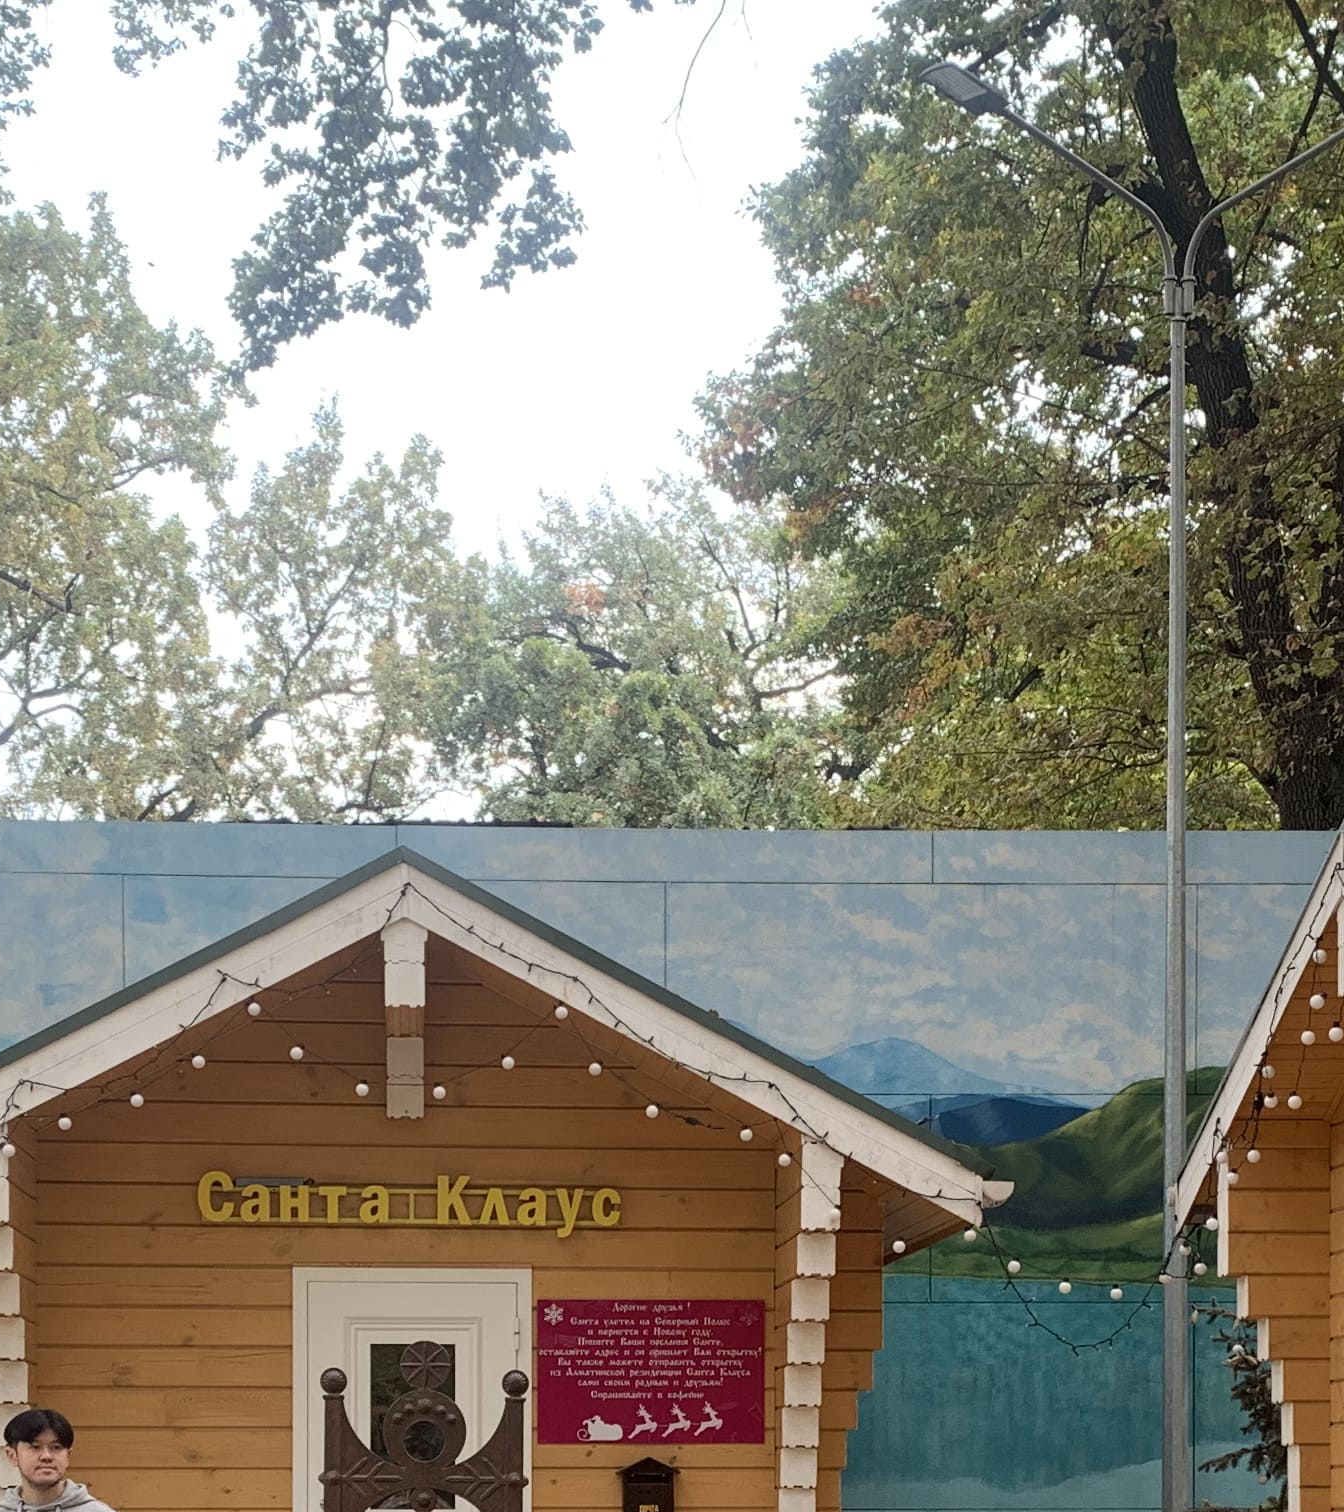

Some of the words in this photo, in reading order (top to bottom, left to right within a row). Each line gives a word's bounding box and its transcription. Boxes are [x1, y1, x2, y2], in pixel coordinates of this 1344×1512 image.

[197, 1170, 390, 1223] Санта
[437, 1175, 623, 1238] Клаус
[612, 1302, 648, 1312] Дорогие
[652, 1304, 683, 1313] друзья
[570, 1316, 599, 1326] Санта
[604, 1319, 635, 1327] улетел
[654, 1317, 699, 1327] Северный
[703, 1317, 731, 1326] Полюс
[653, 1327, 687, 1336] Новому
[594, 1350, 619, 1358] адрес
[558, 1358, 572, 1367] Вы
[575, 1359, 604, 1367] также
[701, 1359, 744, 1368] открытку
[686, 1368, 715, 1376] Санта
